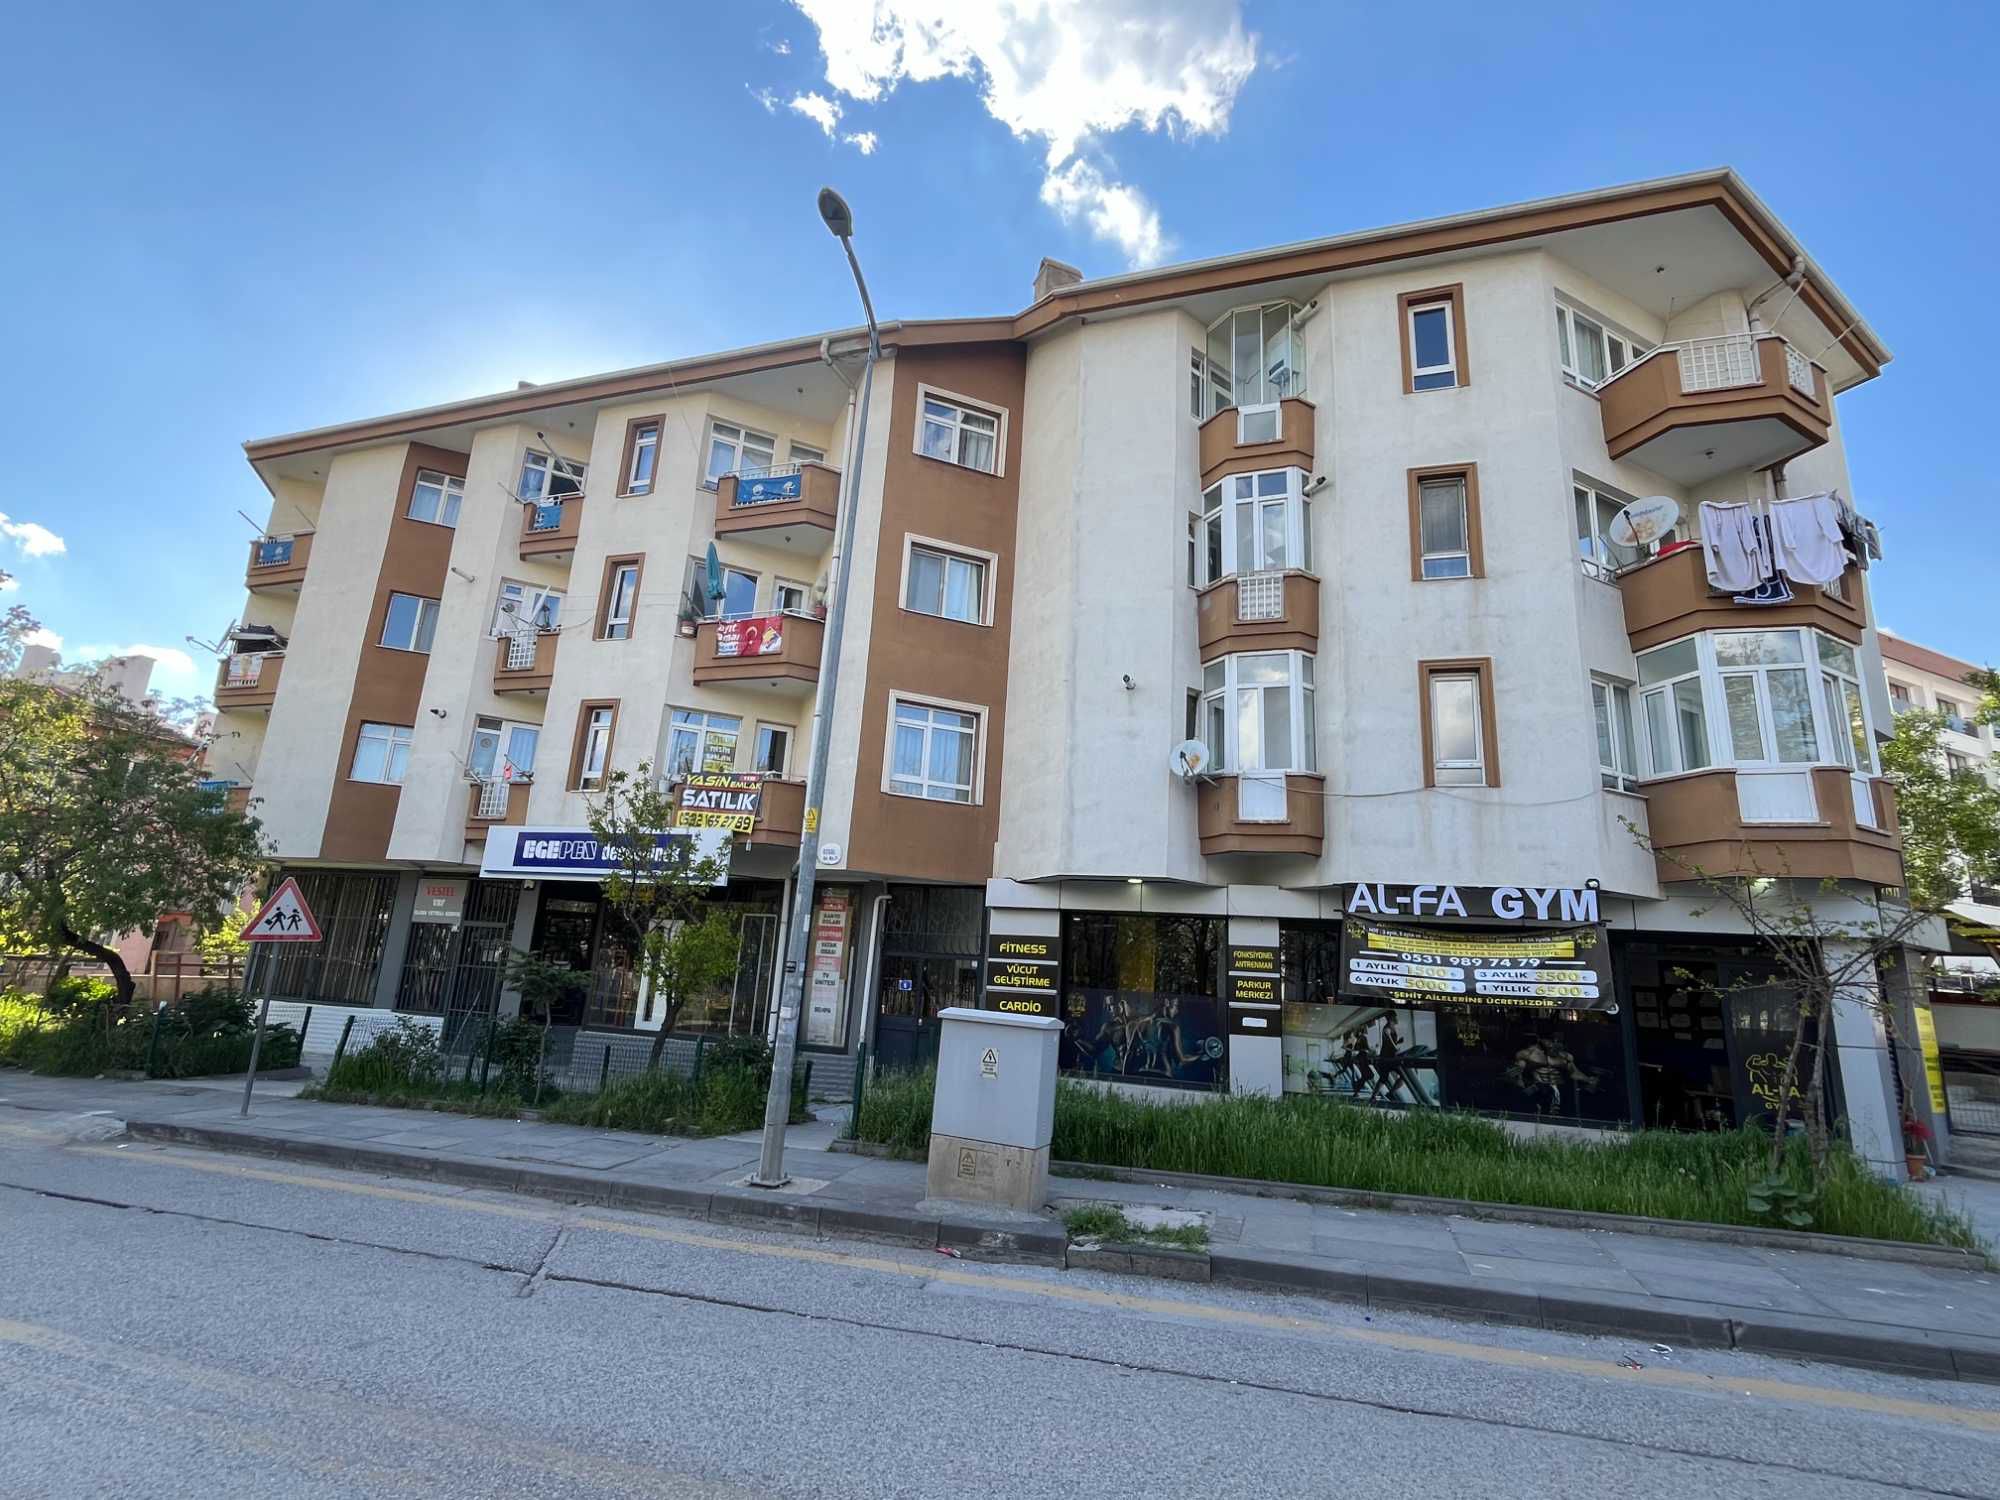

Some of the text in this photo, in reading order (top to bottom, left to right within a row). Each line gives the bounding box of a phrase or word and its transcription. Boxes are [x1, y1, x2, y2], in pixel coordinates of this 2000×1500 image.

[730, 781, 762, 790] EMLAK
[681, 789, 756, 811] SATILIK
[721, 817, 735, 829] 27
[735, 816, 752, 831] 89
[522, 839, 598, 861] EGEPEN
[1349, 883, 1599, 922] AL-FA GYM
[999, 941, 1047, 955] FİTNESS
[1234, 960, 1273, 969] ANTRENMAN
[1366, 962, 1400, 970] AYLIK
[1401, 953, 1541, 967] 0531 989 74 79
[1007, 964, 1039, 975] VÜCUT
[1491, 970, 1528, 979] AYLIK
[993, 974, 1051, 987] GELİŞTİRME
[1237, 980, 1272, 990] PARKUR
[1366, 976, 1400, 985] AYLIK
[1492, 984, 1531, 993] YILLIK
[1235, 990, 1274, 1000] MERKEZİ
[999, 1000, 1042, 1013] CARDİO
[1752, 1083, 1801, 1099] AL-A
